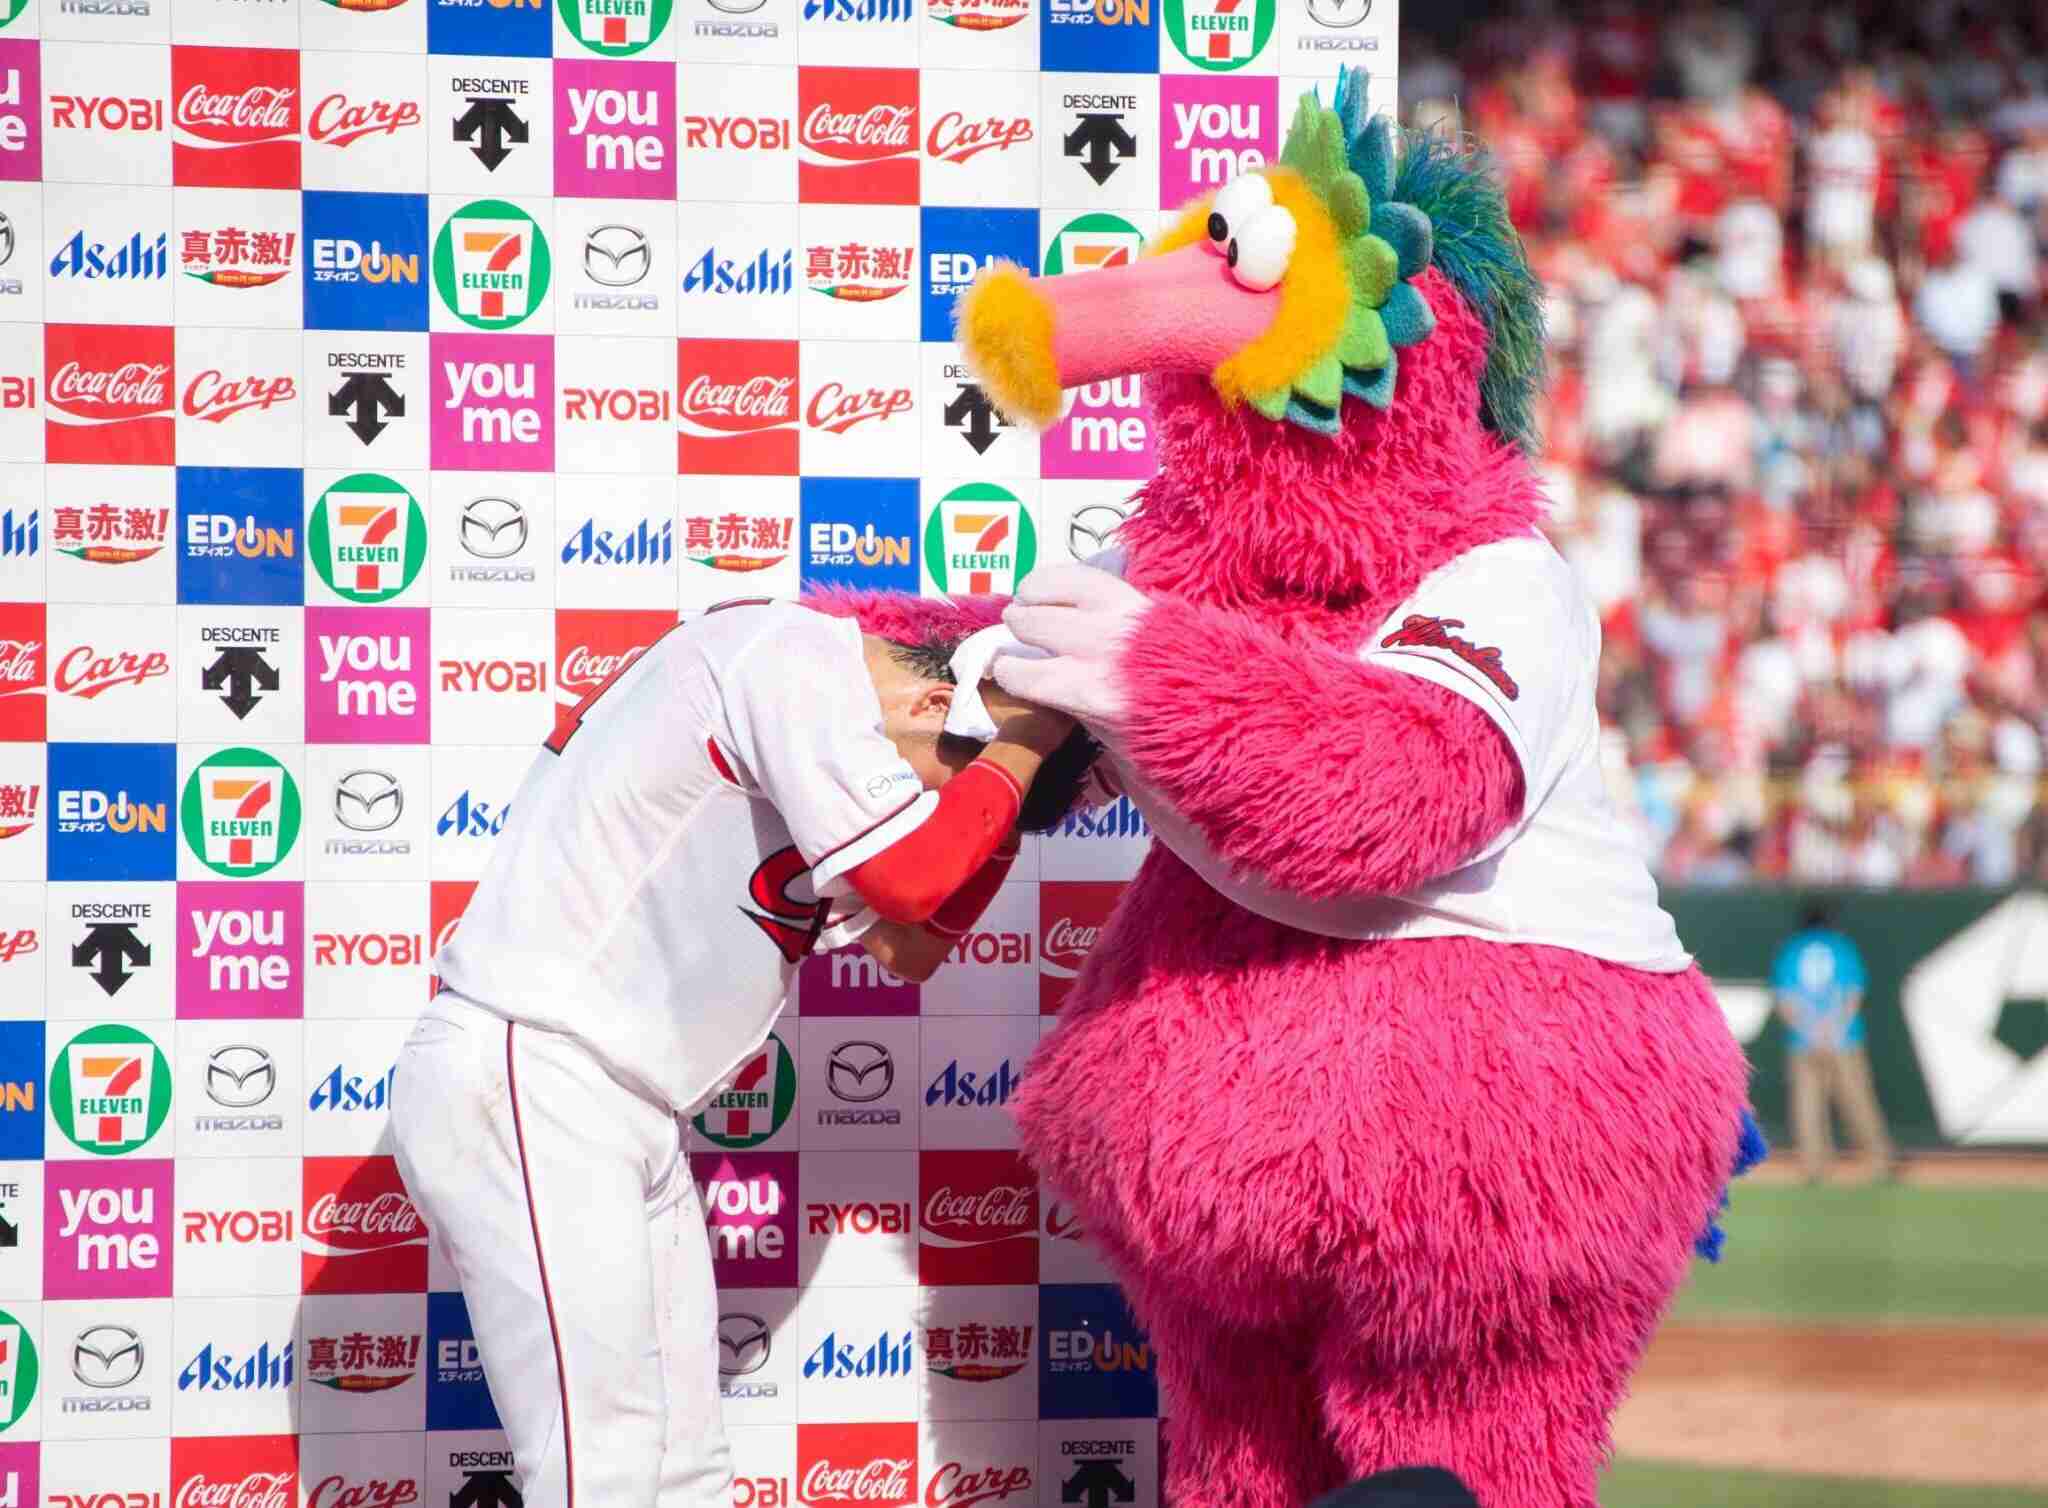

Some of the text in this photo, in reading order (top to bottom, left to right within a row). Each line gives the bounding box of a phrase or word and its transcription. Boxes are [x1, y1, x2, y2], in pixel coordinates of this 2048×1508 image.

[452, 78, 528, 94] DESCENTE
[1064, 95, 1136, 109] DESCENTE
[50, 96, 162, 131] RYOBI
[177, 84, 295, 129] Coca-Cola
[308, 94, 420, 148] Carp
[568, 88, 658, 134] you
[802, 103, 915, 147] Coca-Cola
[1173, 104, 1260, 145] you
[684, 116, 790, 150] RYOBI
[926, 112, 1033, 164] Carp
[585, 135, 664, 170] me
[50, 230, 166, 279] Asahi
[181, 227, 296, 266] 真赤激!
[313, 240, 419, 284] EDION
[806, 243, 914, 281] 真赤激!
[314, 270, 359, 282] エディオン
[683, 248, 792, 294] Asahi
[328, 353, 405, 368] DESCENTE
[49, 362, 169, 405] Coca-Cola
[182, 370, 296, 423] Carp
[444, 362, 535, 407] you
[683, 375, 795, 417] Coca-Cola
[463, 407, 541, 438] me
[563, 388, 670, 421] RYOBI
[806, 383, 913, 434] Carp
[1072, 417, 1146, 450] me
[54, 504, 169, 542] 真赤激!
[187, 515, 293, 558] EDION
[561, 518, 671, 565] Asahi
[685, 513, 793, 551] 真赤激!
[188, 545, 233, 557] エディオン
[810, 524, 910, 566] EDION
[810, 554, 854, 565] エディオン
[202, 628, 280, 642] DESCENTE
[54, 646, 169, 699] Carp
[319, 635, 412, 681] you
[440, 661, 546, 692] RYOBI
[338, 680, 416, 715] me
[58, 791, 165, 832] EDION
[58, 822, 104, 833] エディオン
[72, 904, 151, 918] DESCENTE
[192, 910, 287, 957] you
[313, 934, 421, 965] RYOBI
[209, 957, 290, 991] me
[818, 1110, 901, 1125] mazda
[59, 1188, 156, 1236] you
[308, 1193, 416, 1235] Coca-Cola
[808, 1203, 909, 1235] RYOBI
[924, 1186, 1036, 1226] Coca-Cola
[183, 1210, 293, 1243] RYOBI
[712, 1223, 784, 1260] me
[77, 1233, 159, 1270] me
[308, 1333, 421, 1370] 真赤激!
[803, 1331, 911, 1378] Asahi
[925, 1325, 1034, 1359] 真赤激!
[178, 1341, 293, 1391] Asahi
[1061, 1441, 1134, 1455] DESCENTE
[802, 1459, 912, 1501] Coca-Cola
[925, 1463, 1032, 1508] Carp
